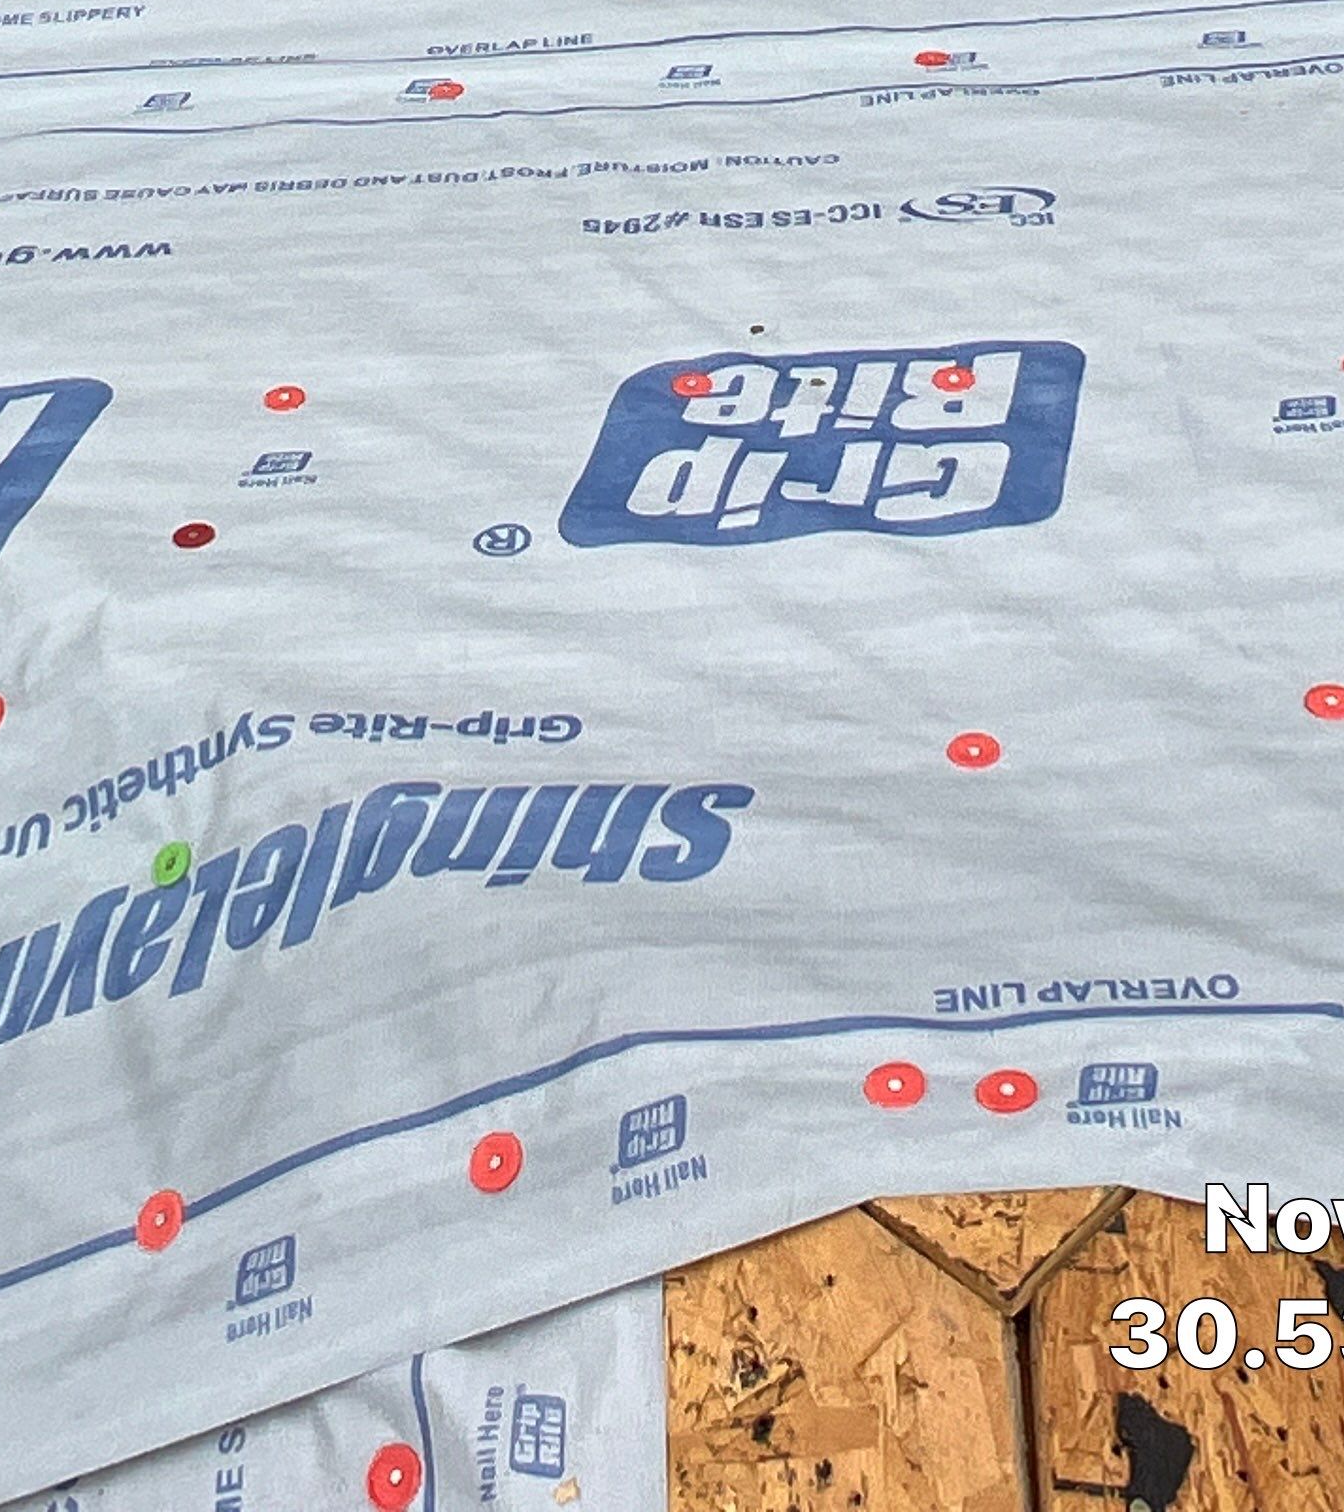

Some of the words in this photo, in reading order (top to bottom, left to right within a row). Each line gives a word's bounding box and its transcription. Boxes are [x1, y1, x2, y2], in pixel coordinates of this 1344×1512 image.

[38, 4, 146, 24] SLIPPERY
[427, 37, 538, 57] OVERLAP
[541, 33, 594, 49] LINE
[1159, 72, 1217, 89] LINE
[858, 90, 915, 108] LINE
[194, 181, 249, 196] MAY
[253, 178, 349, 193] DEBRIS
[353, 174, 410, 189] AND
[415, 171, 479, 186] DUST
[103, 186, 192, 202] CAUSE
[935, 192, 1017, 216] ES
[581, 211, 690, 236] #2945
[698, 210, 765, 230] ESR
[770, 202, 882, 228] ICC-ES
[680, 350, 1022, 438] Rite
[626, 437, 1011, 531] Grip
[310, 711, 583, 746] Grip-Rite
[63, 709, 297, 835] Synthetic
[935, 980, 1026, 1013] LINE
[1037, 972, 1241, 1005] OVERLAP
[1132, 1108, 1182, 1129] Nail
[662, 1154, 708, 1193] Nail
[272, 1295, 314, 1333] Nail
[478, 1444, 504, 1503] Nail
